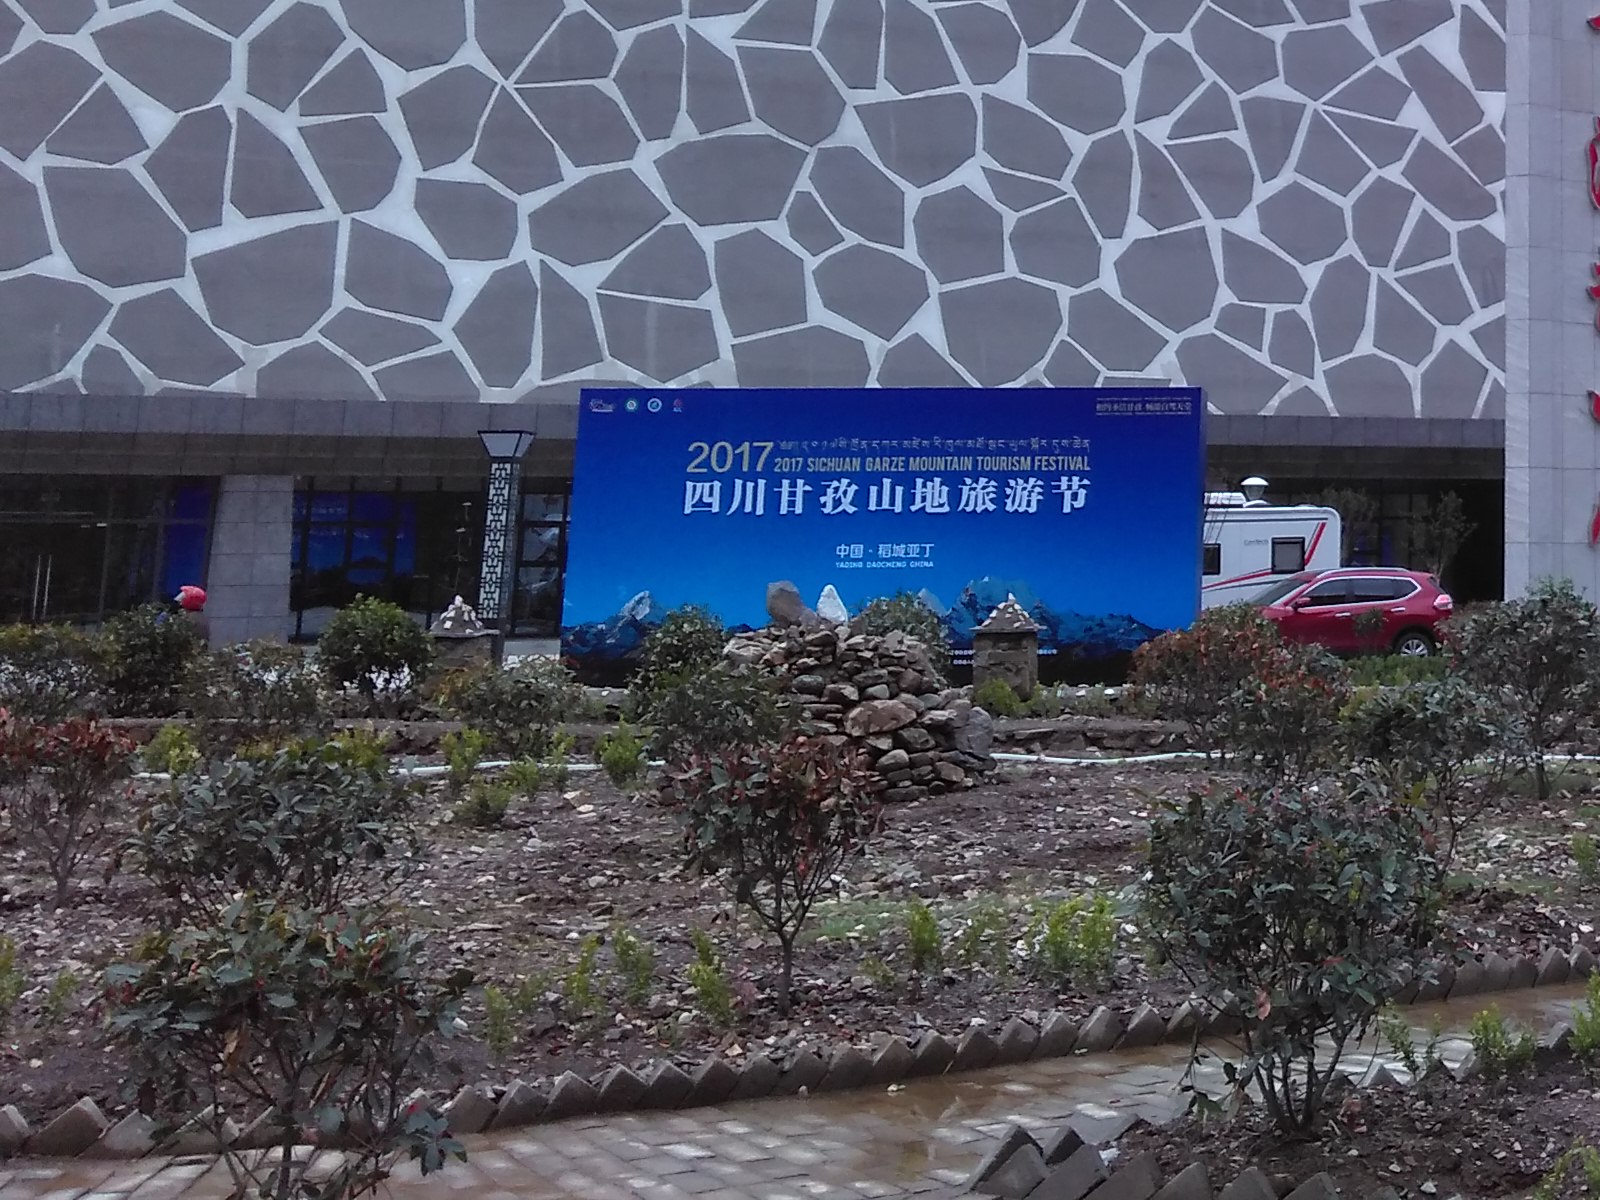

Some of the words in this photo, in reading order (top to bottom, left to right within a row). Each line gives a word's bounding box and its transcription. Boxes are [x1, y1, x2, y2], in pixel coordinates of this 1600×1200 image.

[686, 441, 774, 473] 2017
[774, 457, 803, 472] 2017
[807, 457, 861, 472] SICHUAN
[865, 457, 905, 472] GARZE
[909, 456, 972, 471] MOUNTAIN
[977, 456, 1031, 471] TOURISM
[1034, 455, 1091, 471] FESTIVAL
[683, 476, 1091, 515] 四川甘孜山地旅游节
